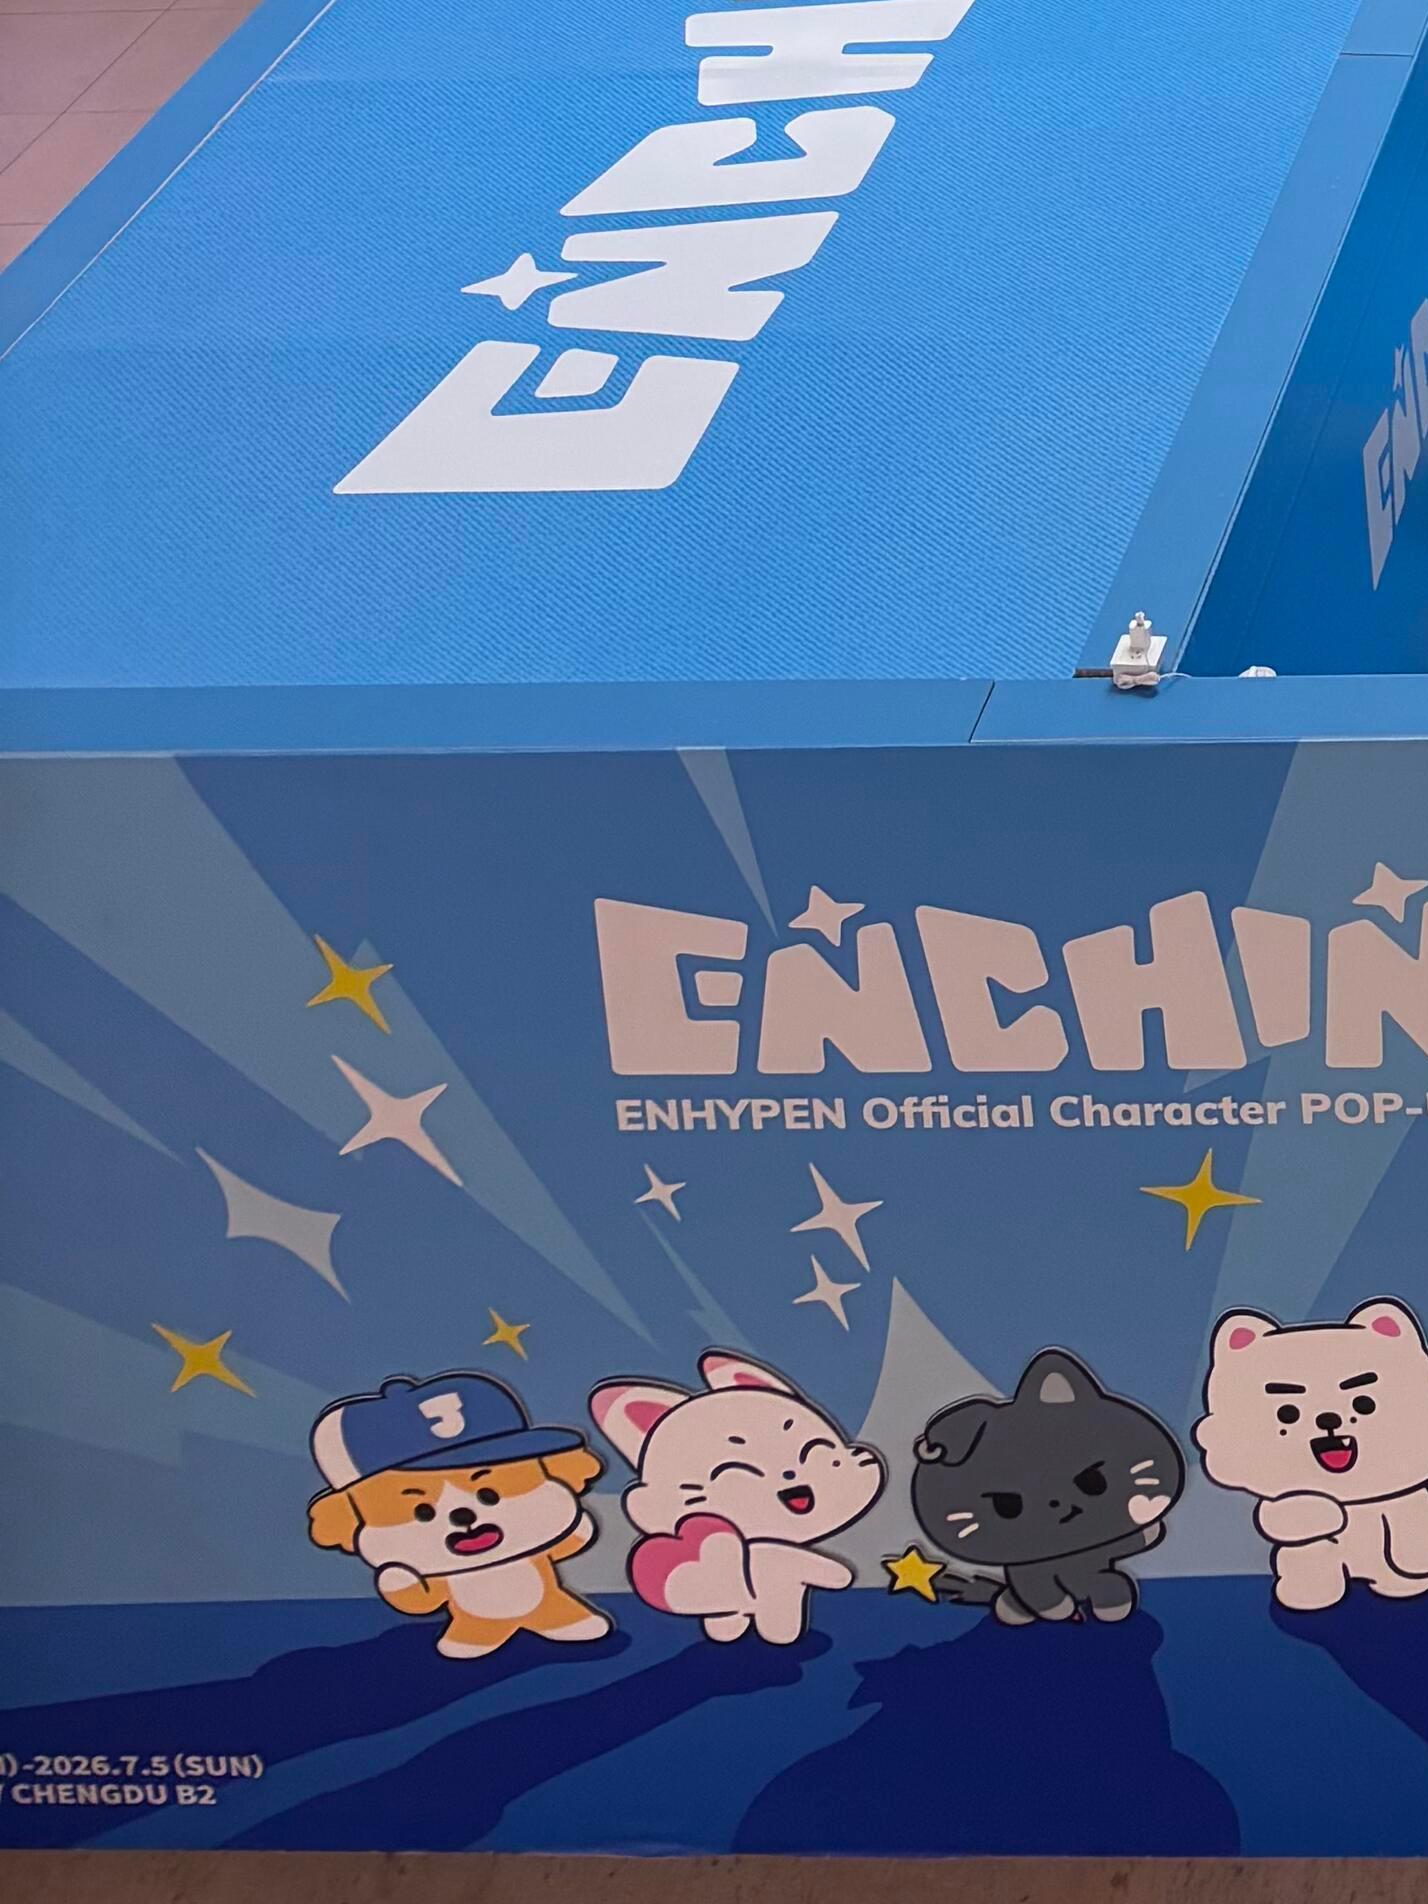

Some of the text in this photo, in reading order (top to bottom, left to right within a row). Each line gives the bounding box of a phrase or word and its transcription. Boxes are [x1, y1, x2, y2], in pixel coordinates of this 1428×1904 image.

[615, 1099, 846, 1133] ENHYPEN
[863, 1096, 1034, 1130] Official
[1048, 1094, 1286, 1130] Character
[11, 1784, 216, 1805] CHENGDU B2
